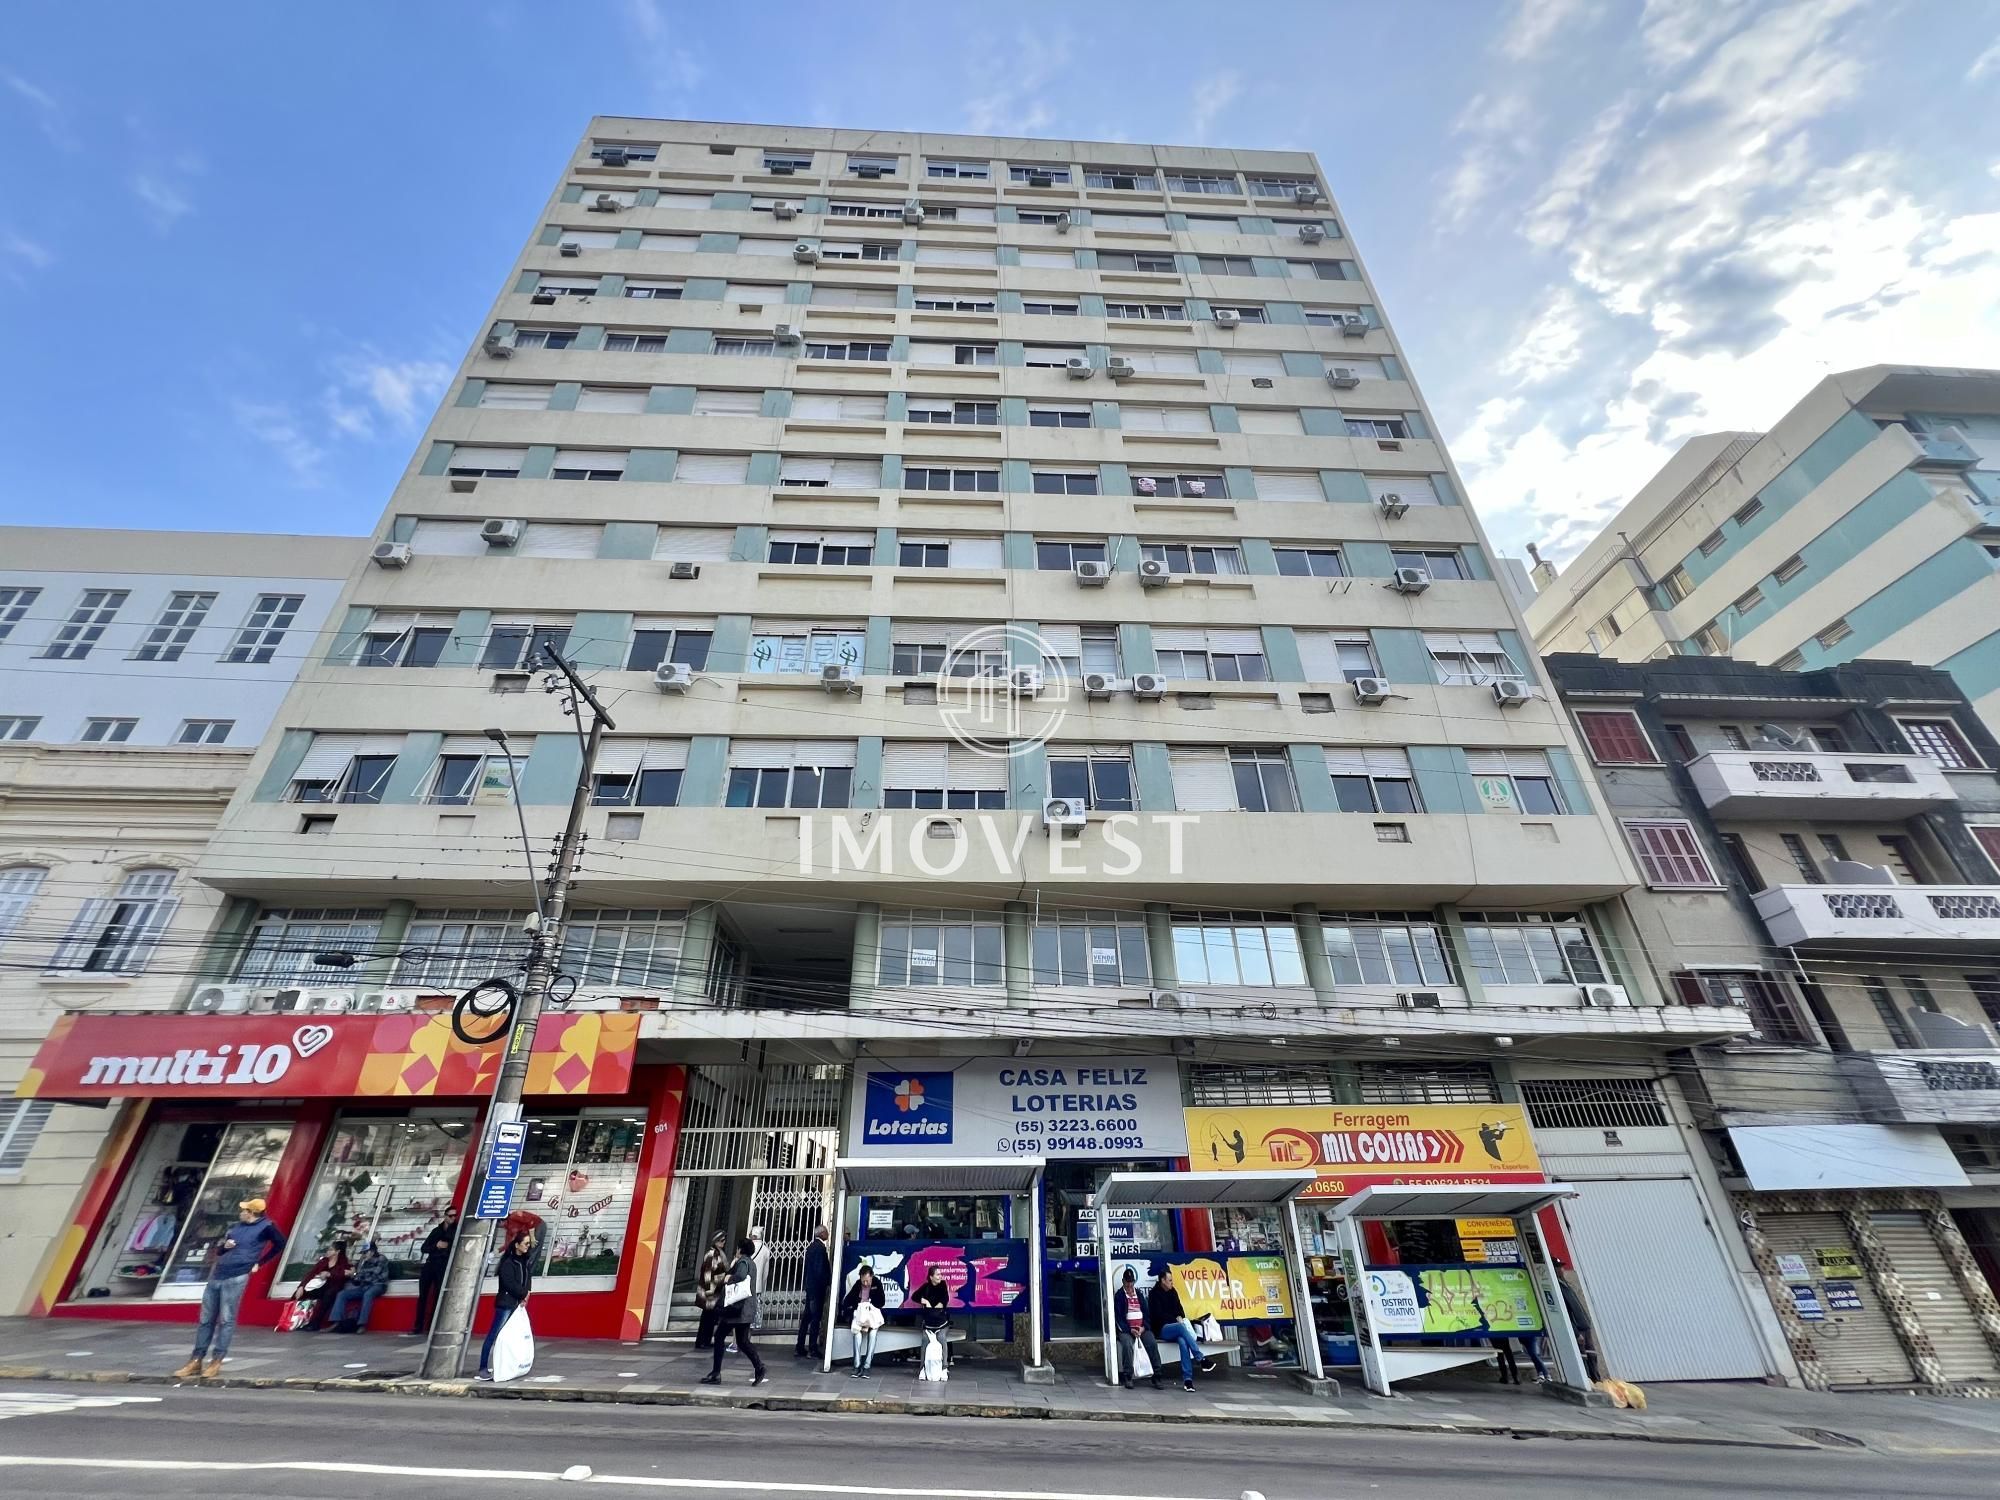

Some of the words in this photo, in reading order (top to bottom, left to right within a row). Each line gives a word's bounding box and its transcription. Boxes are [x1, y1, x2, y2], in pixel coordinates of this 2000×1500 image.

[999, 1068, 1068, 1086] CASA
[1077, 1068, 1148, 1086] FELIZ
[1011, 1093, 1138, 1113] LOTERIAS
[654, 1122, 668, 1134] 601
[868, 1117, 949, 1136] Loterias
[1015, 1120, 1044, 1135] (55)
[1047, 1118, 1138, 1133] 3223.6600
[1333, 1111, 1410, 1131] Ferragem
[1011, 1138, 1041, 1153] (55)
[1046, 1136, 1144, 1151] 99148.0993
[1321, 1133, 1356, 1164] MIL
[1359, 1131, 1428, 1163] COISAS
[1315, 1181, 1345, 1193] 0650
[1080, 1210, 1140, 1218] ACULADA
[1078, 1244, 1090, 1255] 19
[1180, 1266, 1208, 1280] VOCÊ
[1184, 1279, 1245, 1300] VIVER
[1381, 1298, 1414, 1307] DISTRITO
[1383, 1307, 1416, 1316] CRIATIVO
